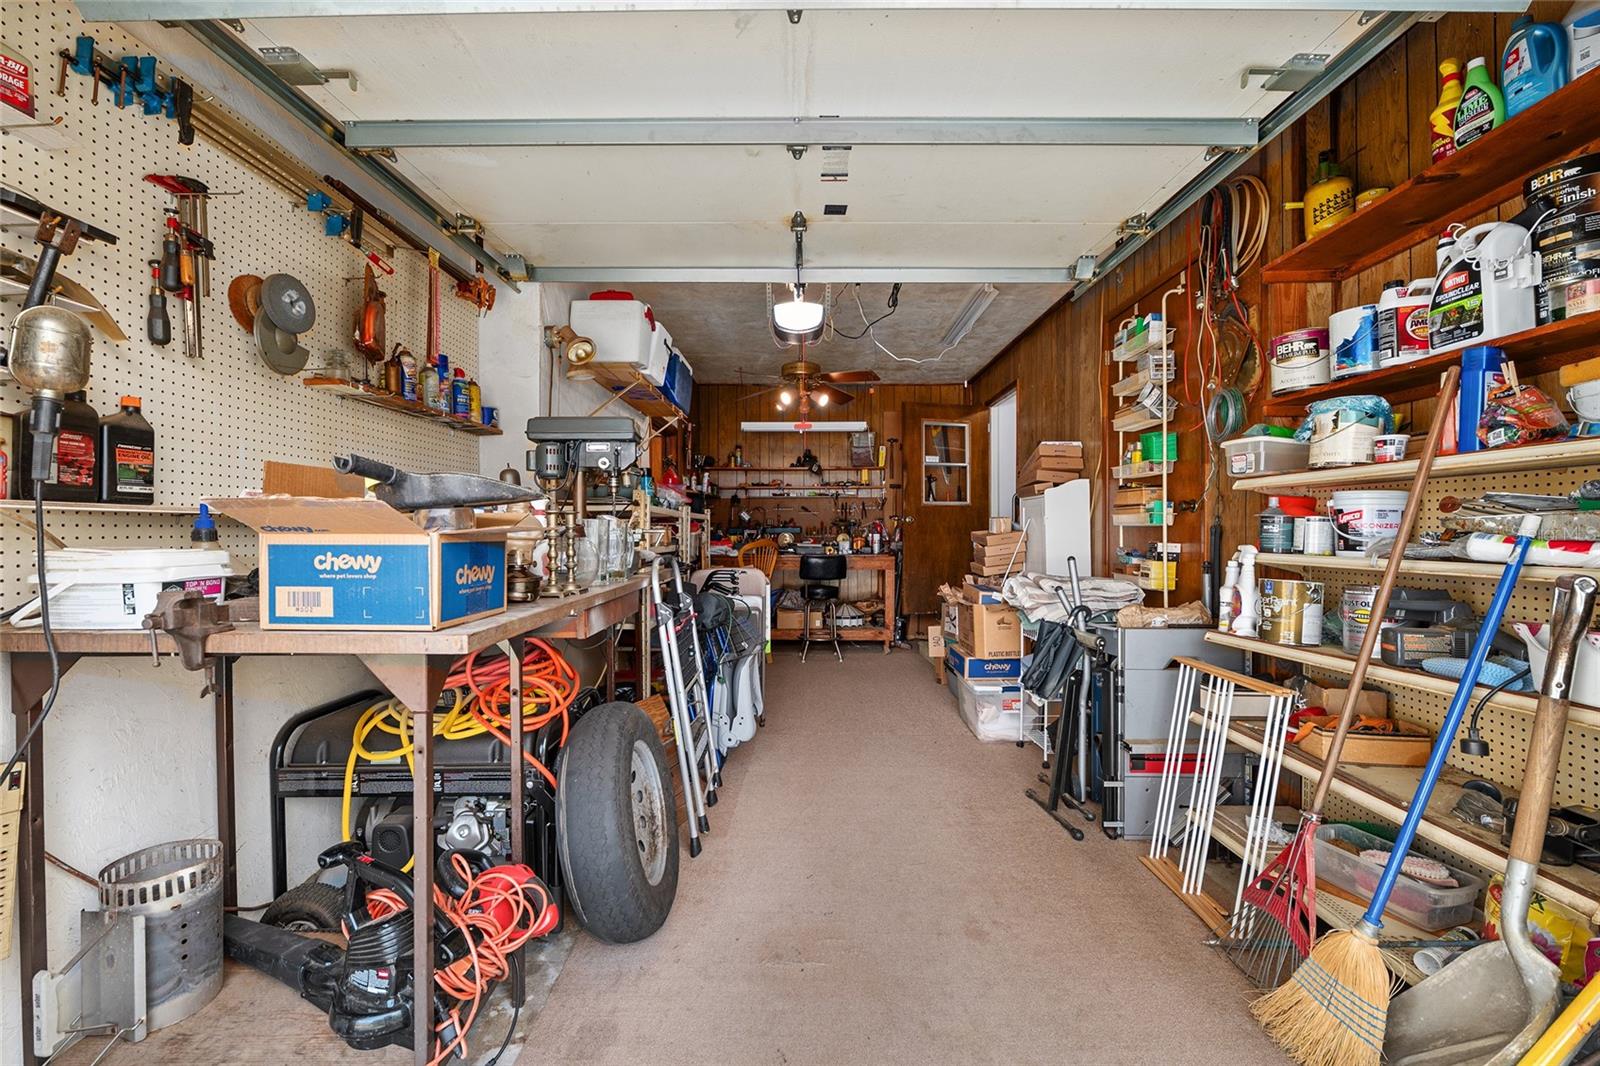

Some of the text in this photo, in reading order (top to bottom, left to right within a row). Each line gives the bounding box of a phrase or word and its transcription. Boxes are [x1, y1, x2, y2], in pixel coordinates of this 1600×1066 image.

[1531, 168, 1564, 191] BEHR
[1556, 187, 1596, 206] Finish
[1444, 273, 1467, 289] ORTHO
[1277, 340, 1304, 355] BEHR
[313, 551, 382, 574] chewy
[455, 563, 496, 585] chewy
[984, 662, 1011, 671] chewy
